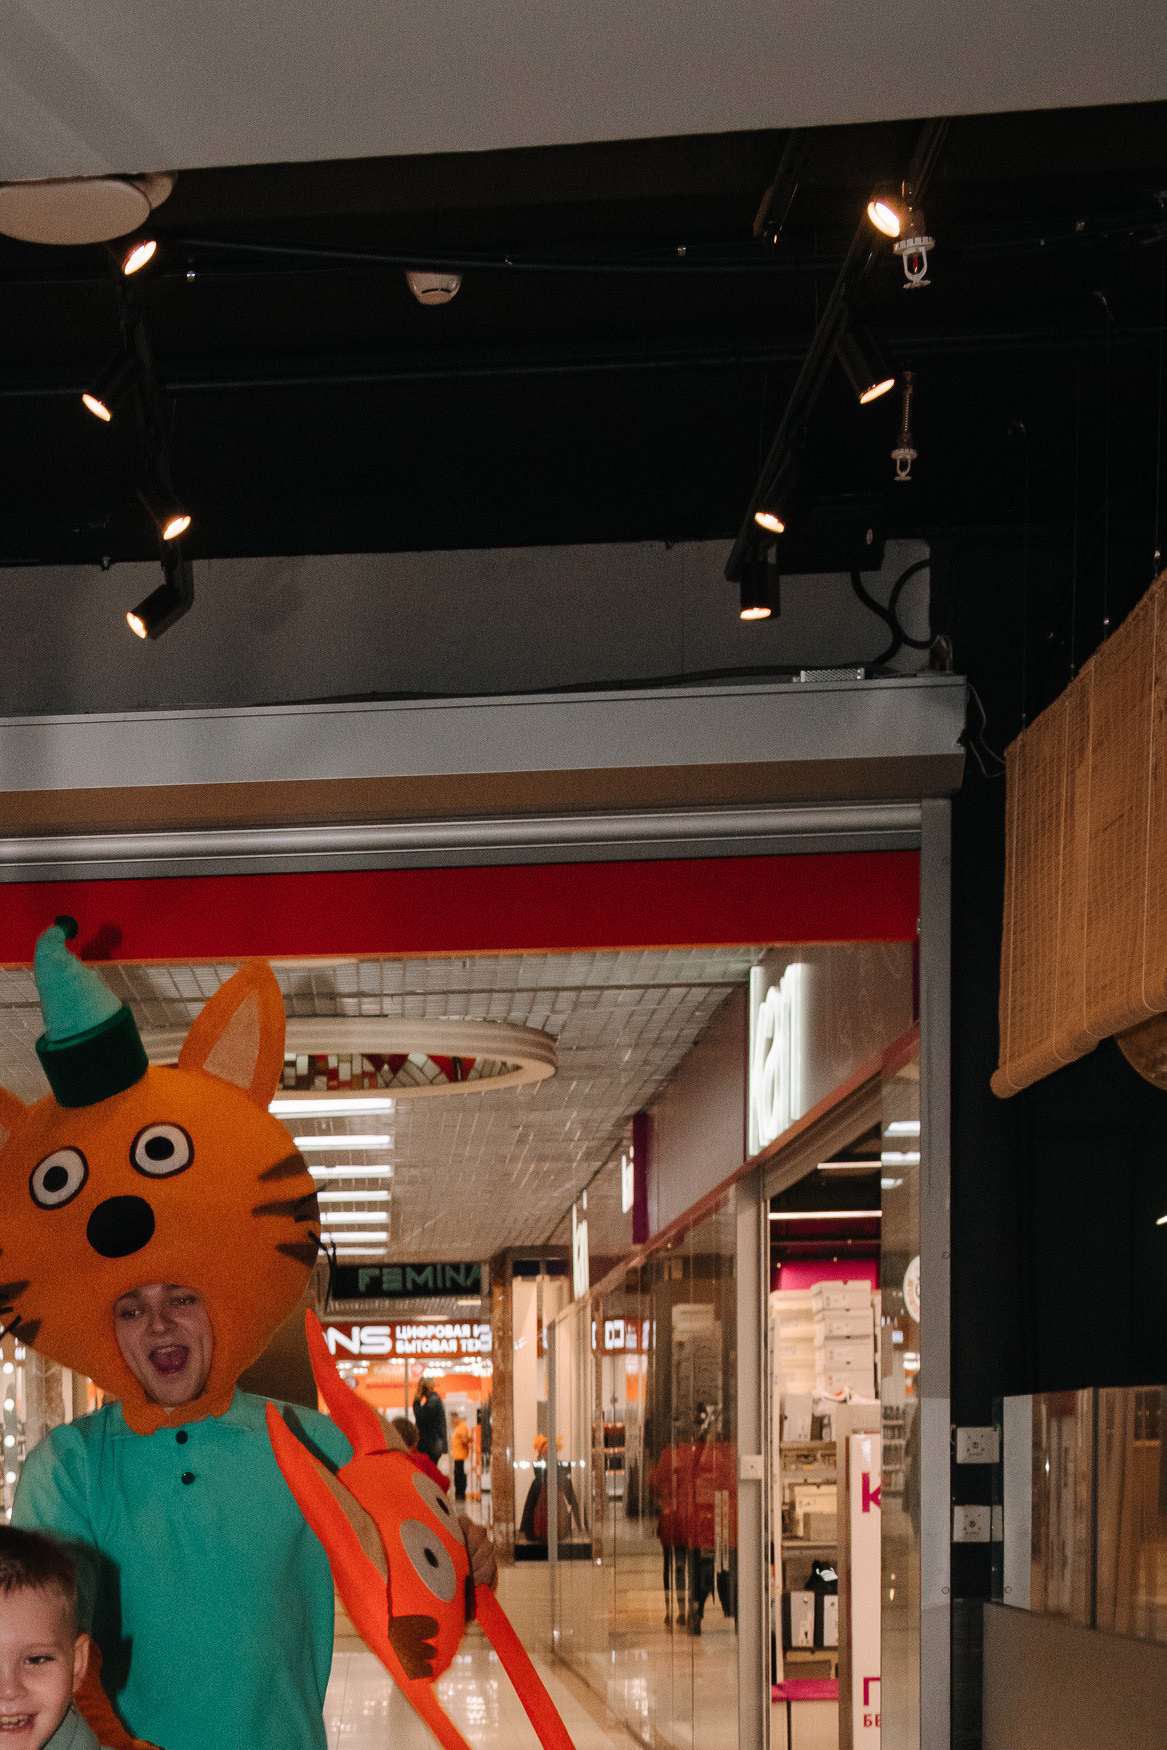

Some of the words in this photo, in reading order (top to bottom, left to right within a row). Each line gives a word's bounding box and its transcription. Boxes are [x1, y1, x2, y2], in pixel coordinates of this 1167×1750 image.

[322, 1325, 393, 1355] NS
[395, 1324, 471, 1340] ЦИФРОВАЯ
[395, 1339, 458, 1354] БЫТОВАЯ
